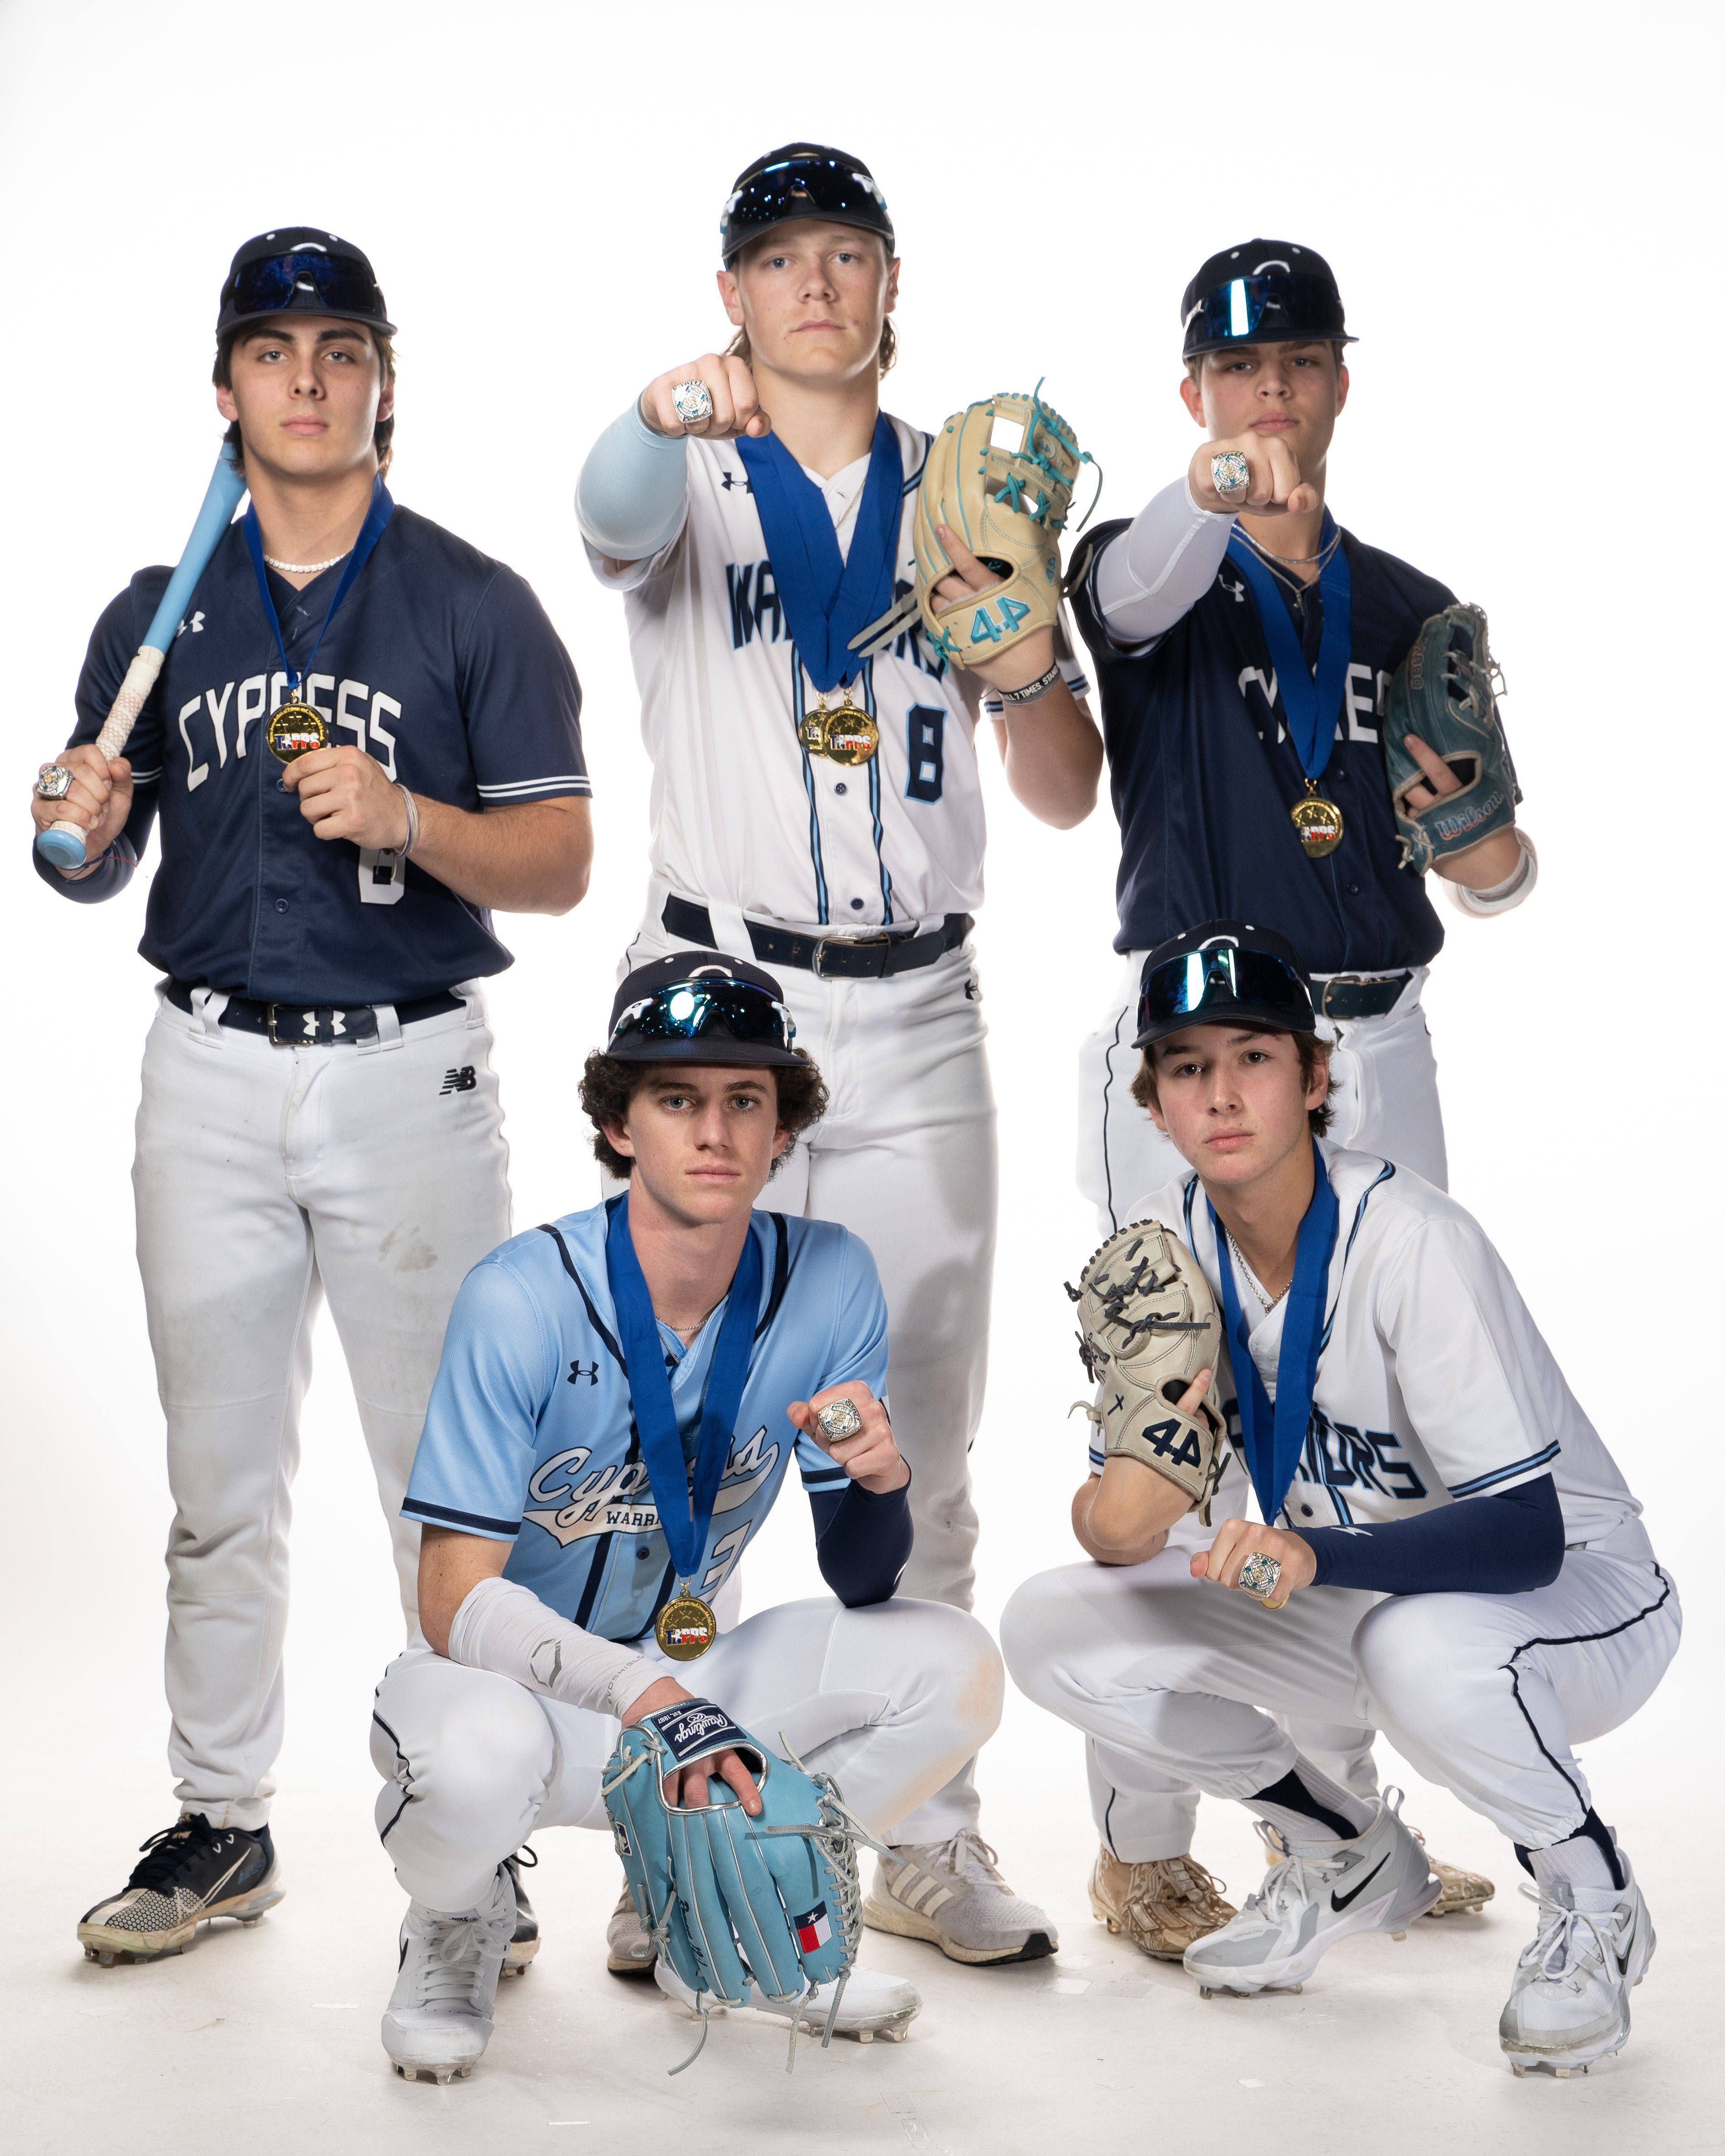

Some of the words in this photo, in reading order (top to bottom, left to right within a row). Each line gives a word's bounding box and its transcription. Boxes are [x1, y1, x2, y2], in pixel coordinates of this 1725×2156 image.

[970, 595, 1031, 645] 44
[274, 732, 320, 750] TAPPS
[828, 734, 871, 751] TAPPS
[904, 703, 949, 806] 8
[1301, 825, 1336, 842] APPS
[1435, 791, 1504, 841] Wilson
[1141, 1418, 1202, 1468] 44
[529, 1425, 780, 1528] Cyps
[665, 1627, 708, 1646] TAPPS
[607, 1655, 644, 1705] EVOSHIELD
[658, 1715, 671, 1724] 1887
[674, 1713, 728, 1743] Rawlings
